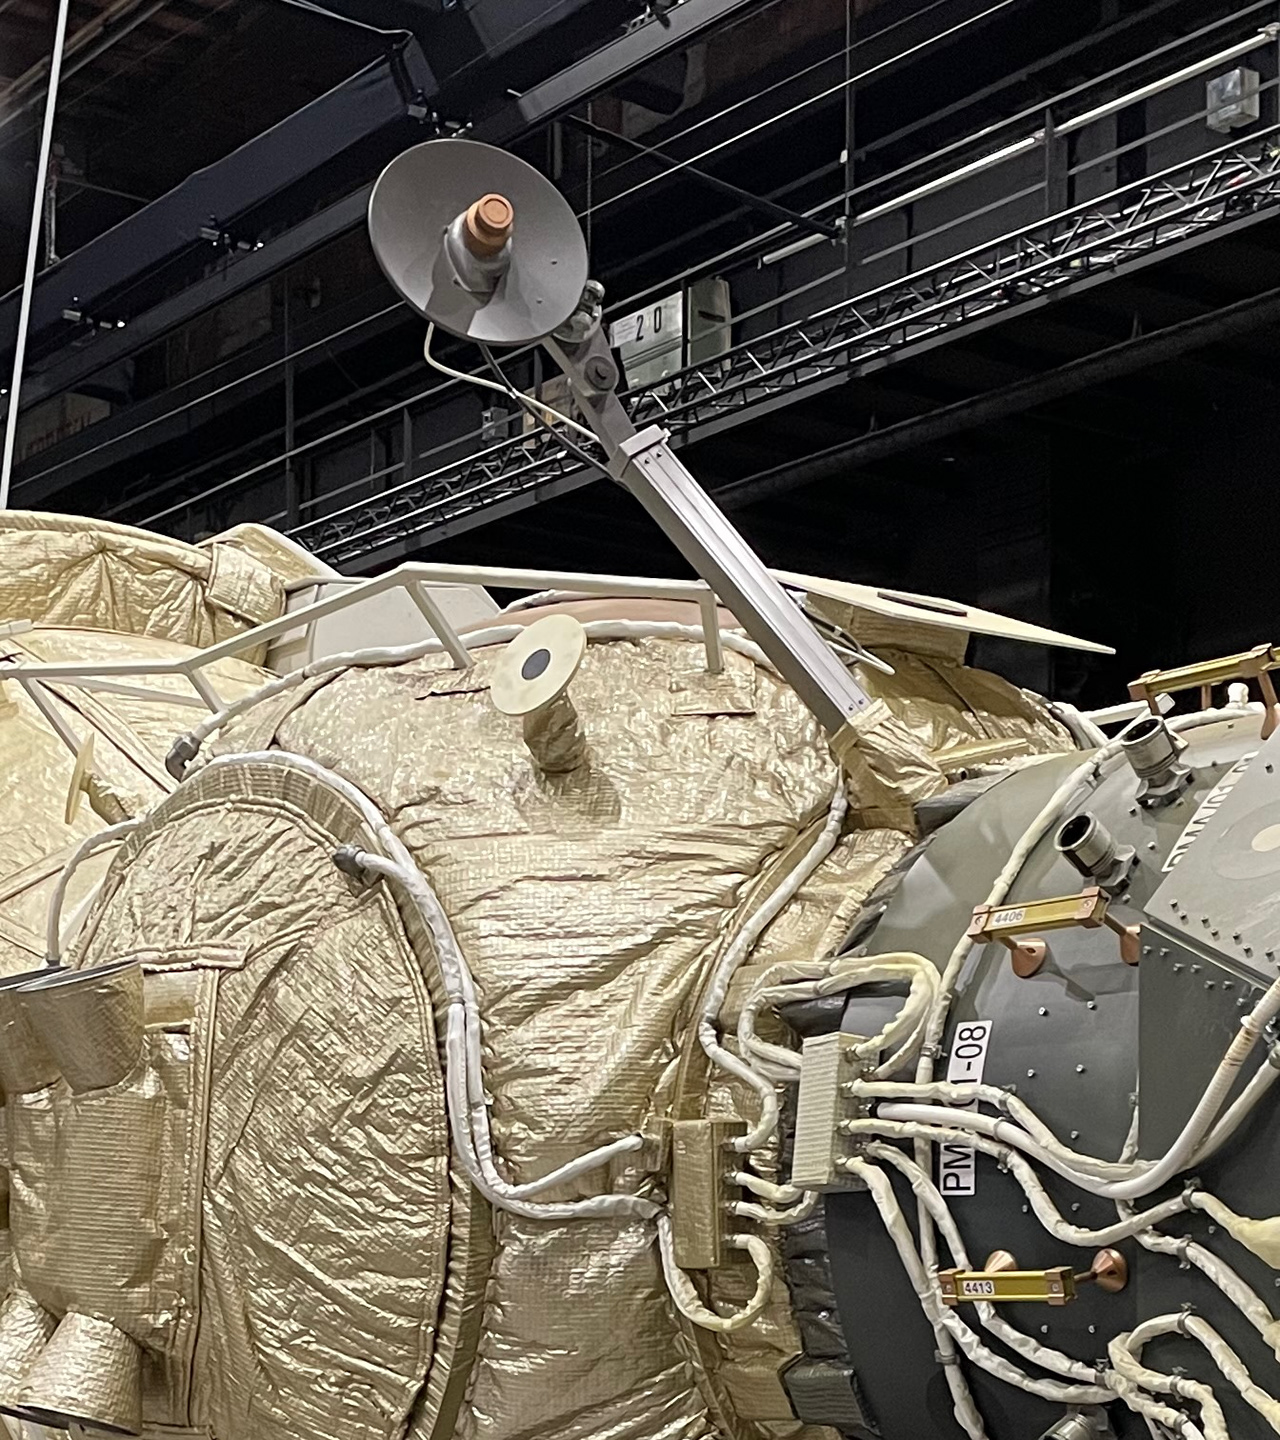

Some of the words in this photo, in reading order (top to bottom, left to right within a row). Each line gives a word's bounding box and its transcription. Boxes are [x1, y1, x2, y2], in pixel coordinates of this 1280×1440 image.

[995, 910, 1024, 924] 4406
[943, 1024, 987, 1192] PM1-08
[964, 1281, 993, 1296] 4413
